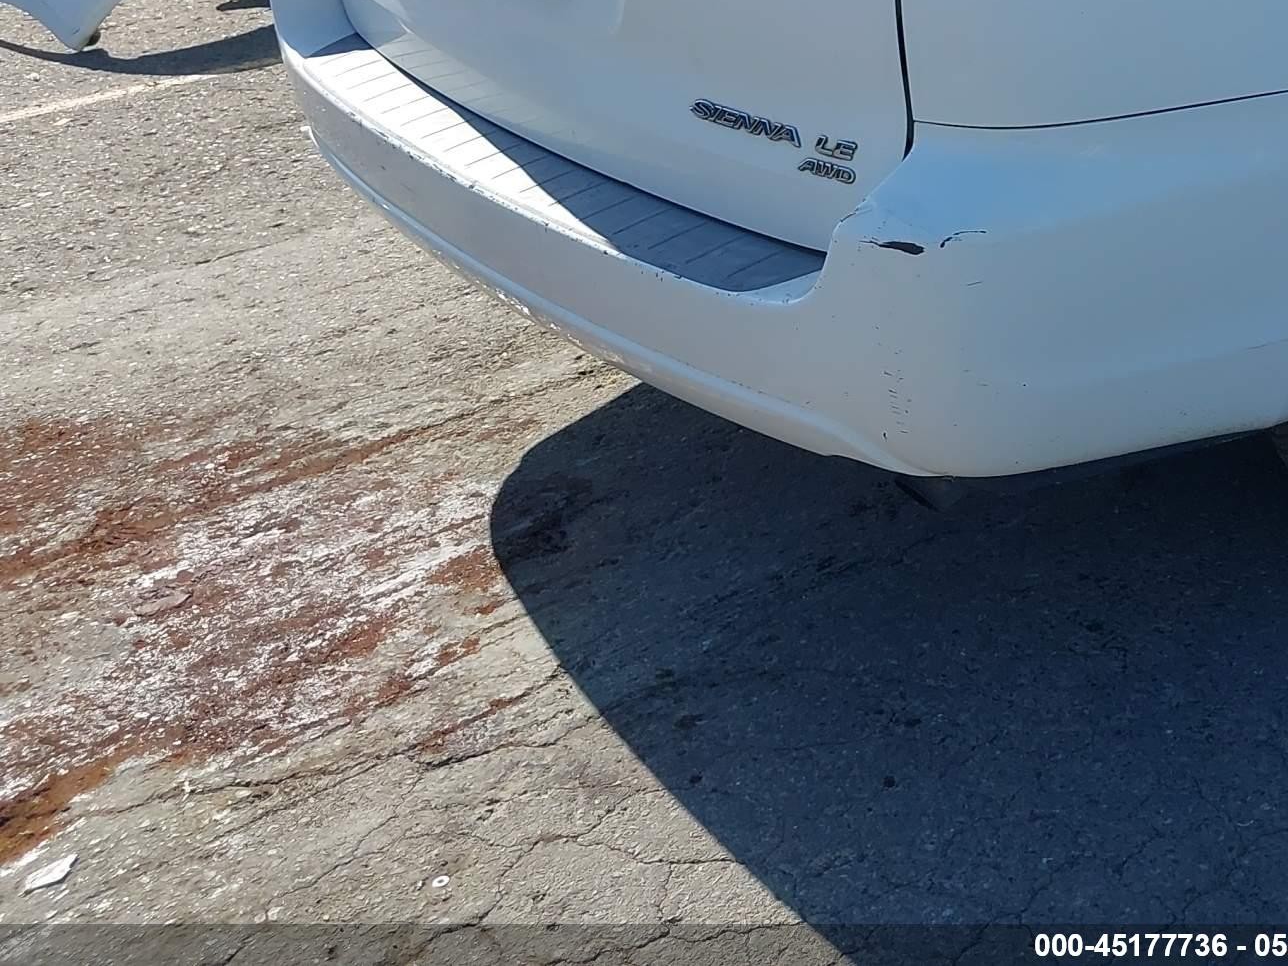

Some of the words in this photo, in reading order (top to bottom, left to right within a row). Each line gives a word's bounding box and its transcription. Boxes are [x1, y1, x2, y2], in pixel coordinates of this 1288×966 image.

[689, 98, 802, 148] SIENNA
[815, 135, 858, 162] LE
[798, 157, 857, 185] AWD
